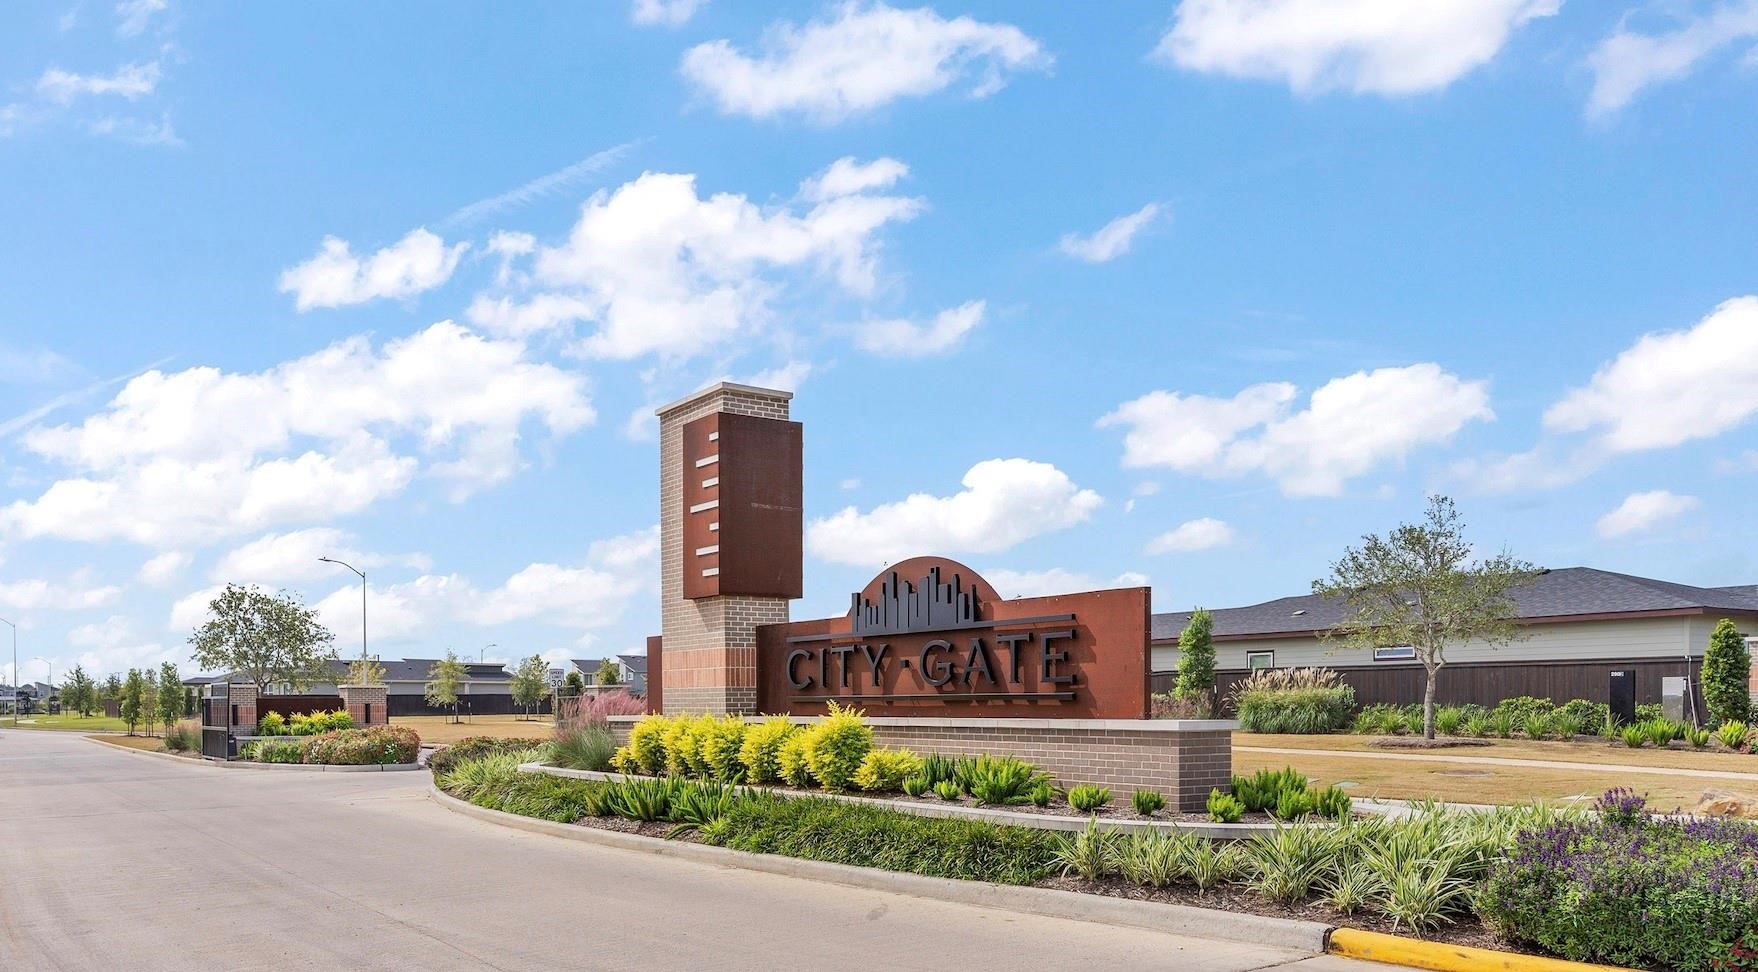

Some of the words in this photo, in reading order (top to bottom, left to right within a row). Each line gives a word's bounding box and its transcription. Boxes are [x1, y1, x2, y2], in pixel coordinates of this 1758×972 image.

[786, 643, 890, 690] CITY
[919, 628, 1077, 686] GATE
[551, 679, 563, 688] 30
